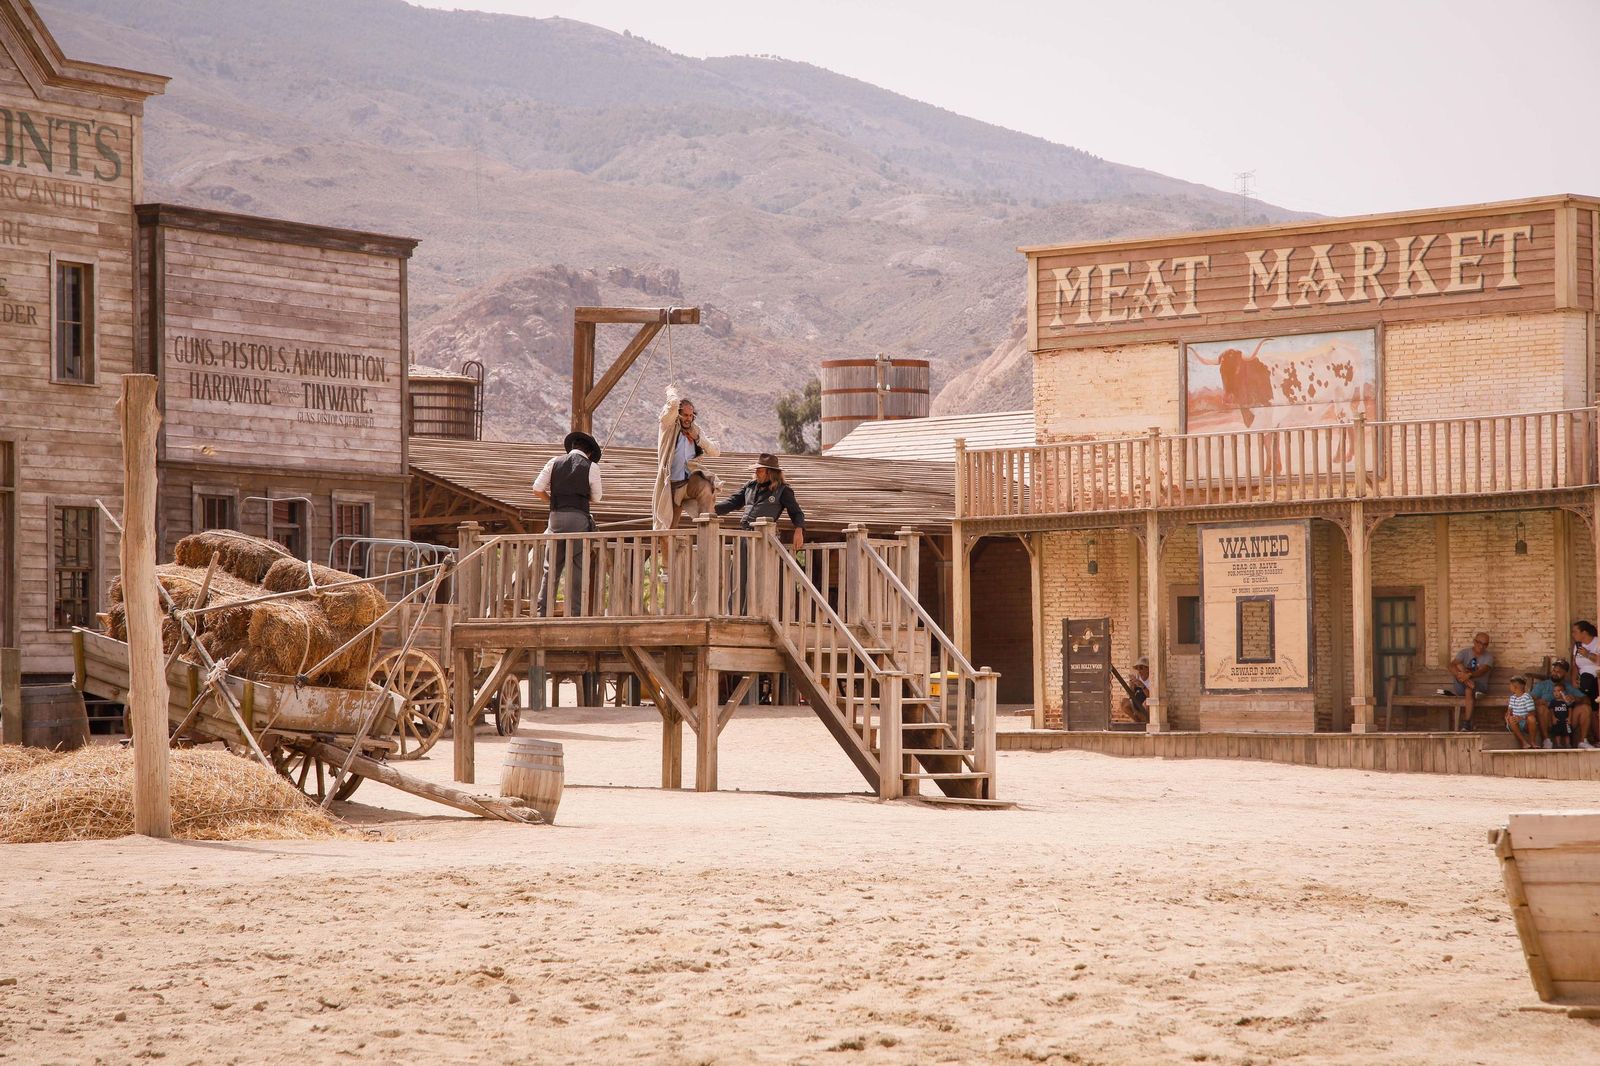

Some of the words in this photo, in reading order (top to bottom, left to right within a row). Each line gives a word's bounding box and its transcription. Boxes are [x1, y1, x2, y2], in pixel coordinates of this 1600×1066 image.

[1050, 256, 1211, 330] MEAT
[1243, 225, 1533, 313] MARKET
[189, 371, 272, 406] HARDWARE
[301, 382, 373, 414] TINWARE.
[1218, 534, 1290, 559] WANTED
[1231, 666, 1258, 676] REWARD
